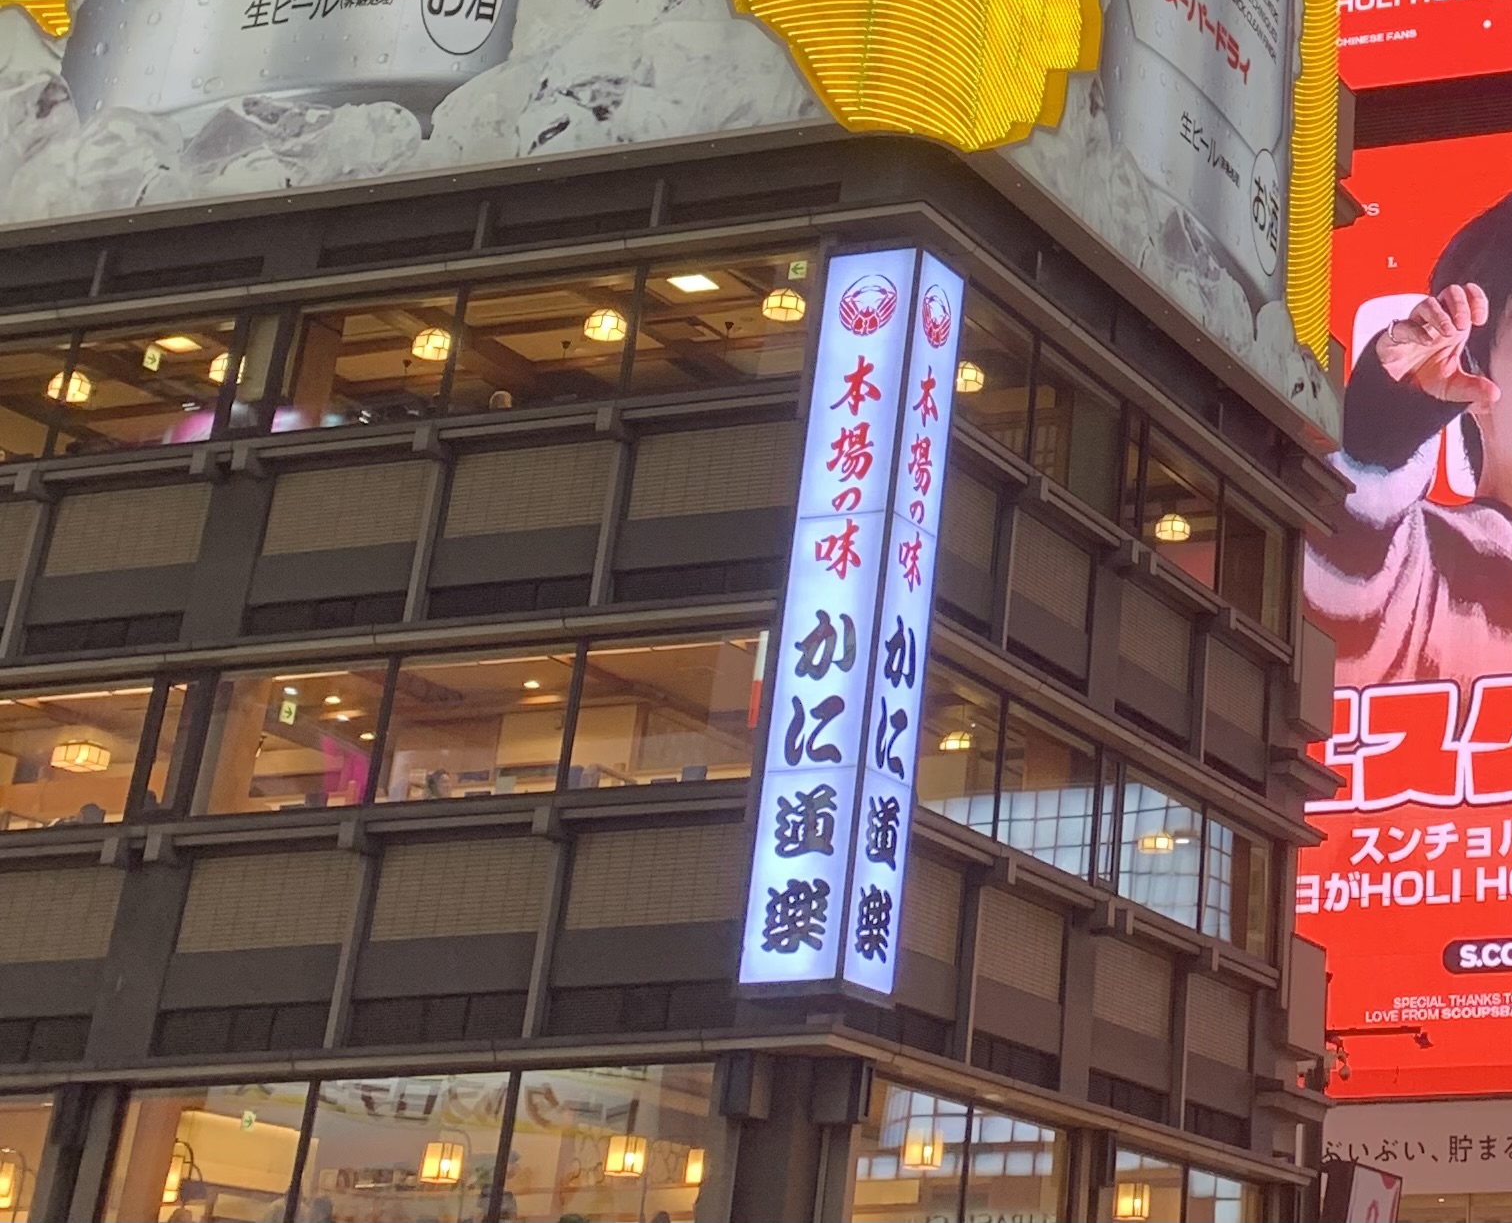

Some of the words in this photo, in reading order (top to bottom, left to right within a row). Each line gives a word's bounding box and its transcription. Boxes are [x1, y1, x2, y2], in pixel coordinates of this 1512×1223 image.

[1386, 29, 1417, 40] FANS
[814, 354, 882, 581] 本場の味
[898, 365, 941, 595] 本場の味
[1393, 994, 1446, 1009] SPECIAL
[1449, 993, 1501, 1007] THANKS
[1365, 1009, 1399, 1023] LOVE
[1401, 1007, 1439, 1021] FROM
